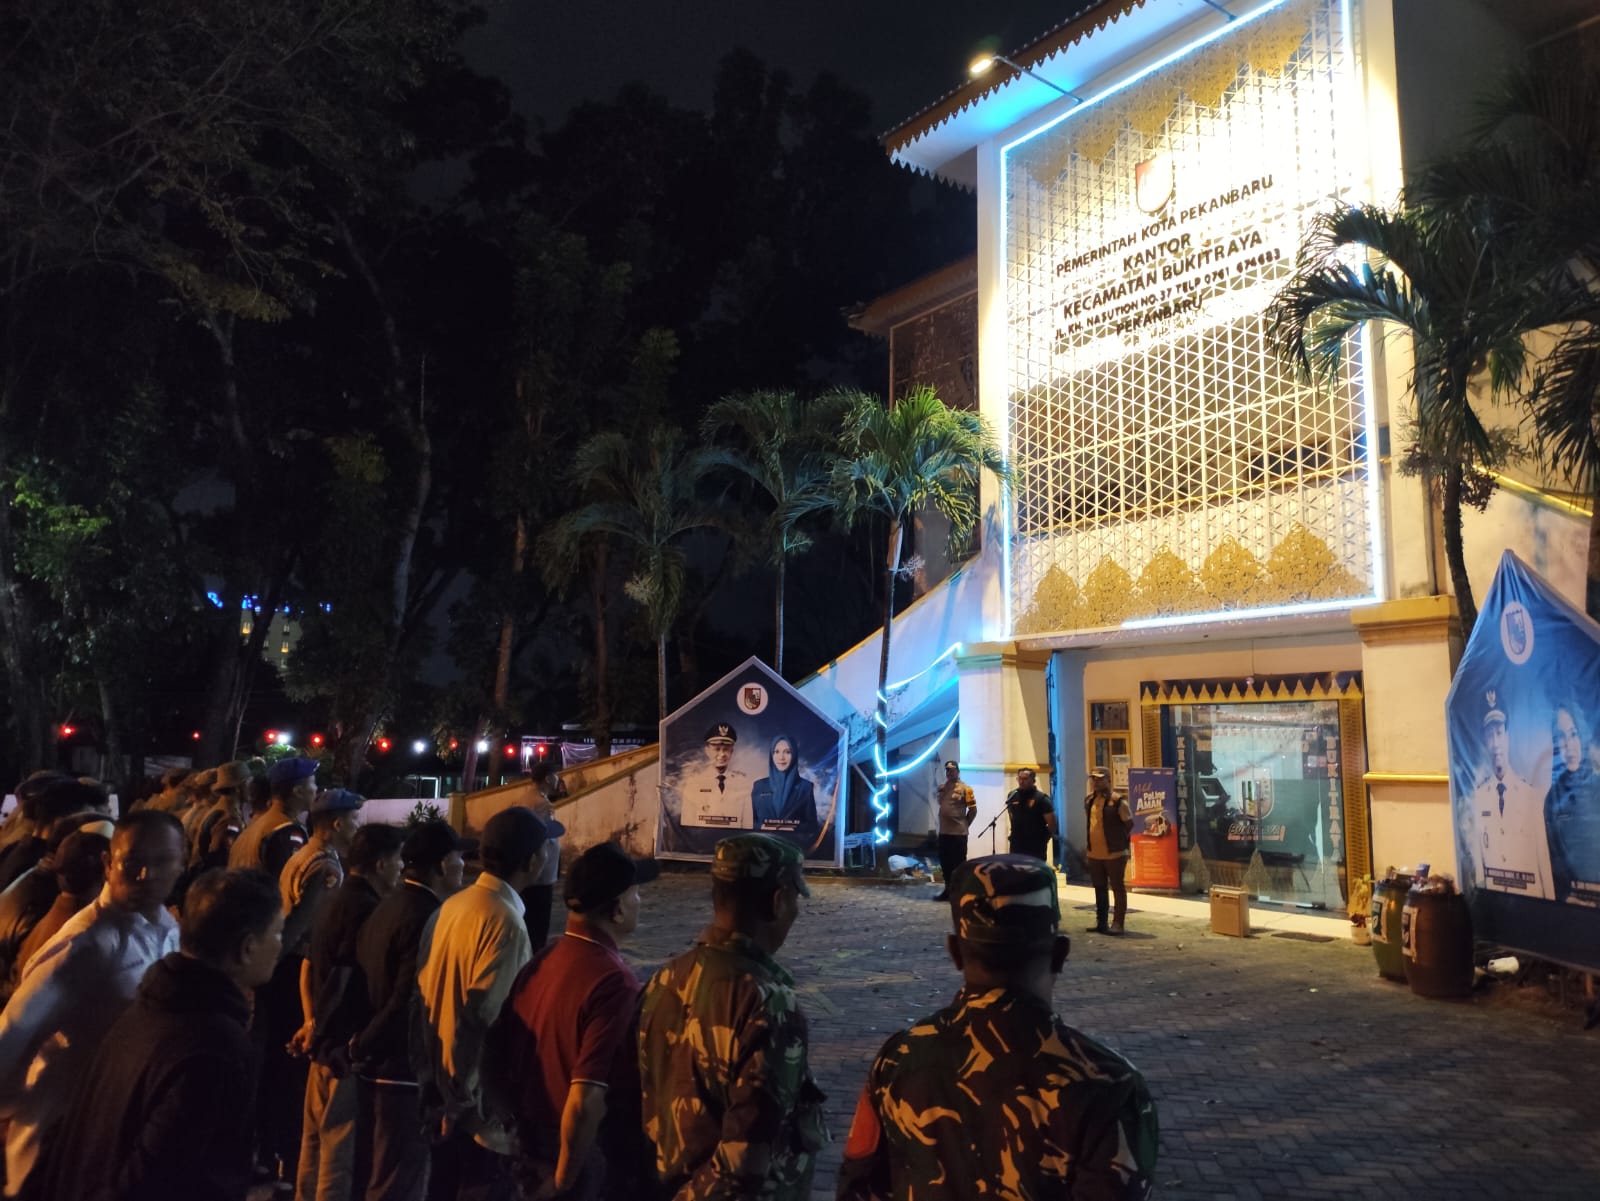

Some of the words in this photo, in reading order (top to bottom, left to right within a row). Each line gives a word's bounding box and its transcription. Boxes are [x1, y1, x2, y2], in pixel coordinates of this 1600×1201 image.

[1056, 232, 1137, 277] PEMERINTAH
[1141, 216, 1177, 242] KOTA
[1180, 174, 1274, 224] PEKANBARU
[1123, 232, 1192, 273] KANTOR
[1063, 270, 1158, 319] KECAMATAN
[1162, 230, 1263, 281] BUKITRAYA
[1086, 300, 1138, 327] NASUTION
[1116, 294, 1203, 337] PEKANBARU
